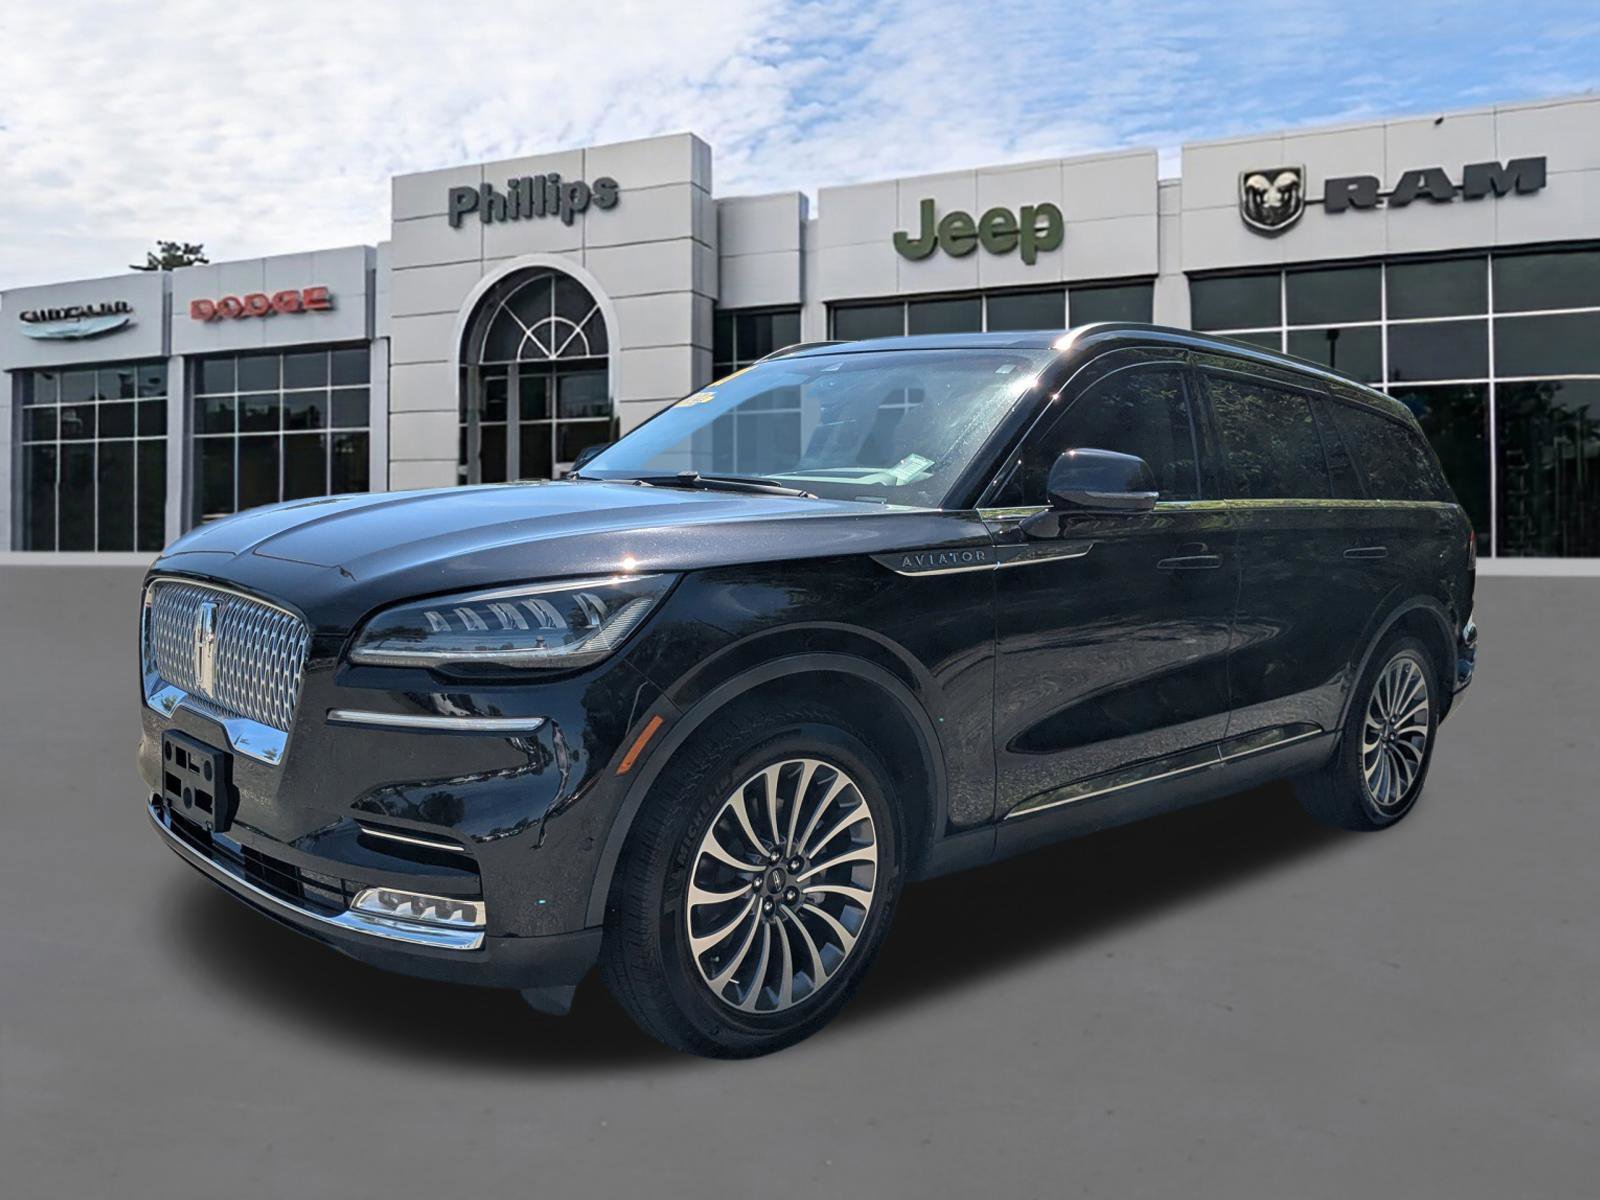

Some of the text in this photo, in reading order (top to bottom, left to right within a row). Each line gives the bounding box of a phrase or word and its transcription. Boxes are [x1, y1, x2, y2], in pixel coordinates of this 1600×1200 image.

[448, 172, 619, 229] Phillips
[1323, 156, 1547, 214] RAM
[893, 198, 1065, 266] Jeep
[190, 286, 332, 321] DODGE
[901, 550, 986, 568] AVIATOR
